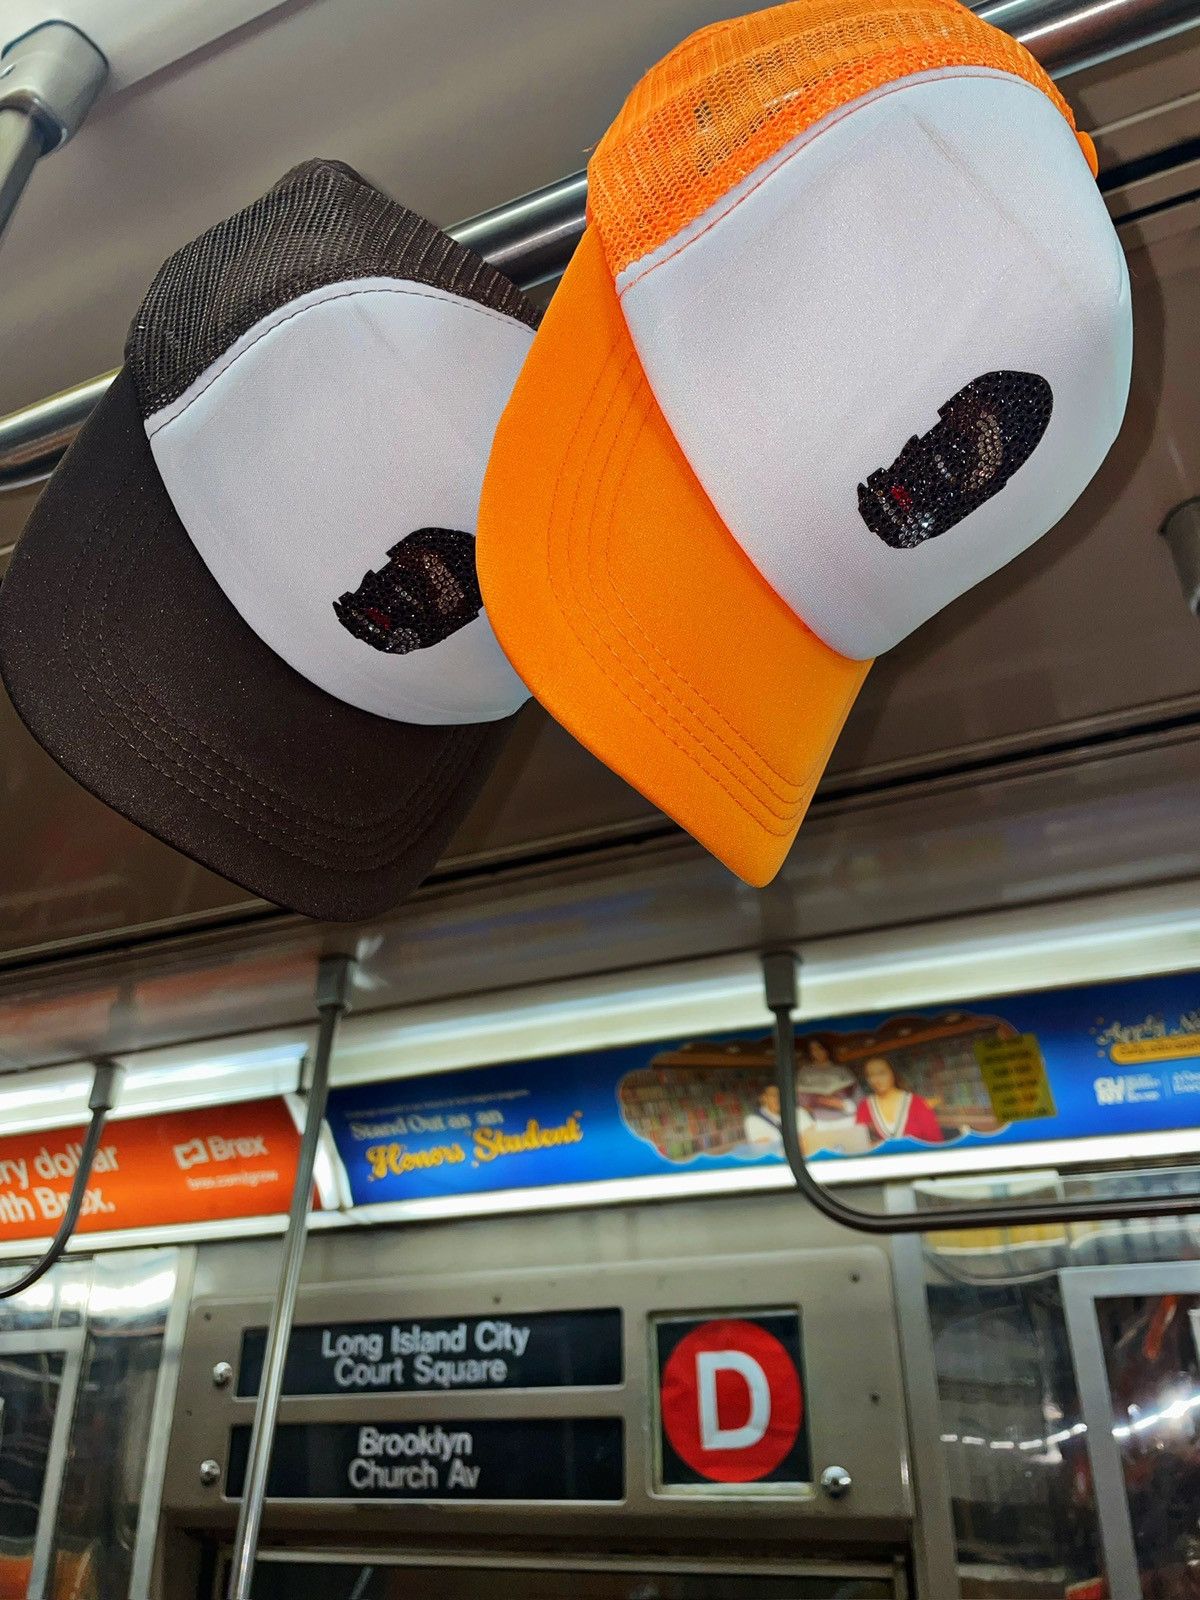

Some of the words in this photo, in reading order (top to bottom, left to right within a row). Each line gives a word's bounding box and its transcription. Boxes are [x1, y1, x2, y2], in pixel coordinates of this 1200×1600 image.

[406, 1114, 446, 1134] Out
[206, 1135, 270, 1162] Brex
[365, 1142, 466, 1180] Honors
[472, 1115, 584, 1163] Student
[0, 1157, 29, 1191] ry
[320, 1328, 385, 1363] Long
[390, 1322, 468, 1356] Island
[473, 1320, 532, 1357] City
[333, 1356, 405, 1387] Court
[412, 1353, 509, 1389] Square
[695, 1349, 772, 1451] D
[356, 1425, 475, 1463] Brooklyn
[347, 1457, 440, 1491] Church
[446, 1457, 482, 1490] Av
